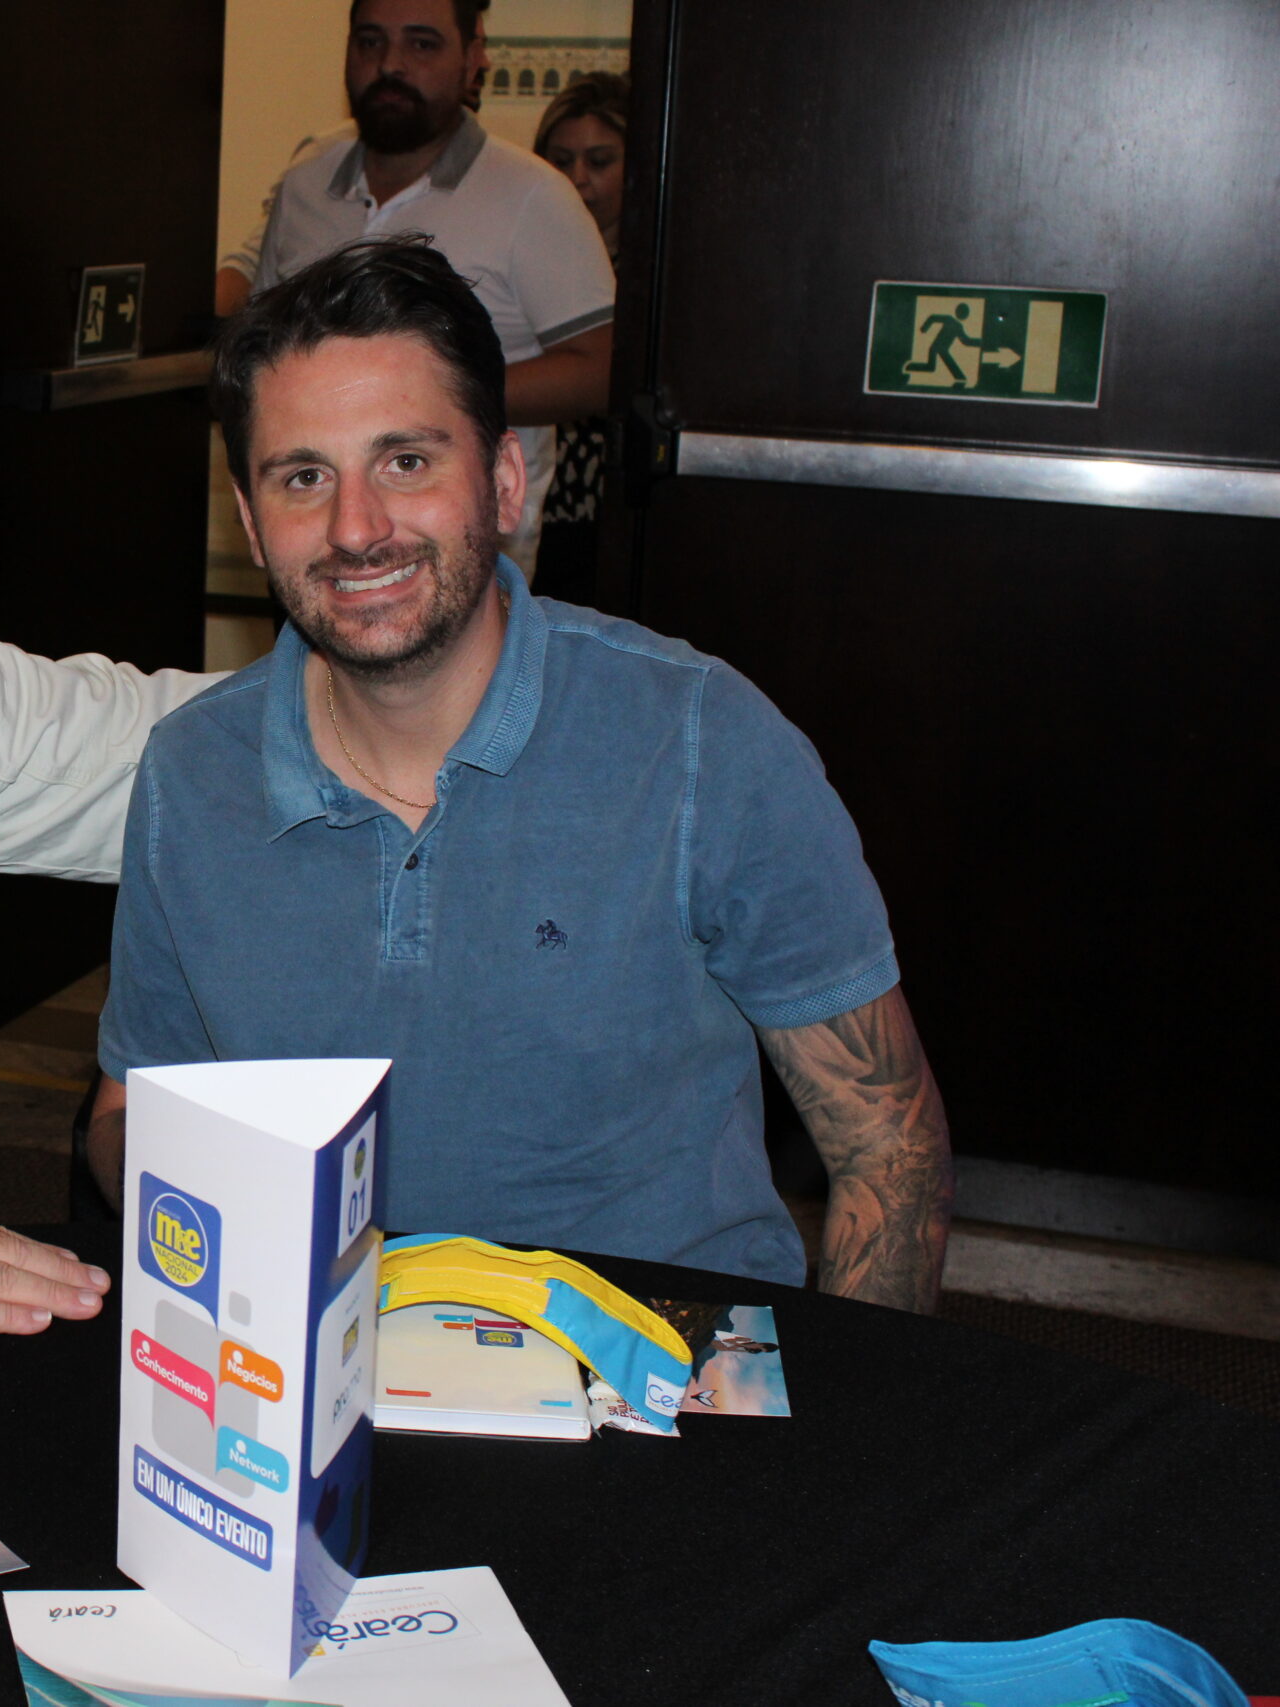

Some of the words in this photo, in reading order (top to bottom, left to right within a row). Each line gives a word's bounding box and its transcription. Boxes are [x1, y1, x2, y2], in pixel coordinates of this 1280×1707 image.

[348, 1178, 366, 1236] 01
[154, 1245, 200, 1277] NACIONAL
[165, 1261, 188, 1282] 2024
[136, 1348, 209, 1402] Conhecimento
[227, 1358, 278, 1394] Negócios
[229, 1447, 280, 1484] Network
[138, 1458, 154, 1493] EM
[156, 1469, 174, 1508] UM
[177, 1481, 214, 1531] ÚNICO
[216, 1508, 267, 1560] EVENTO
[48, 1605, 117, 1623] Ceará
[323, 1610, 458, 1649] Ceará
